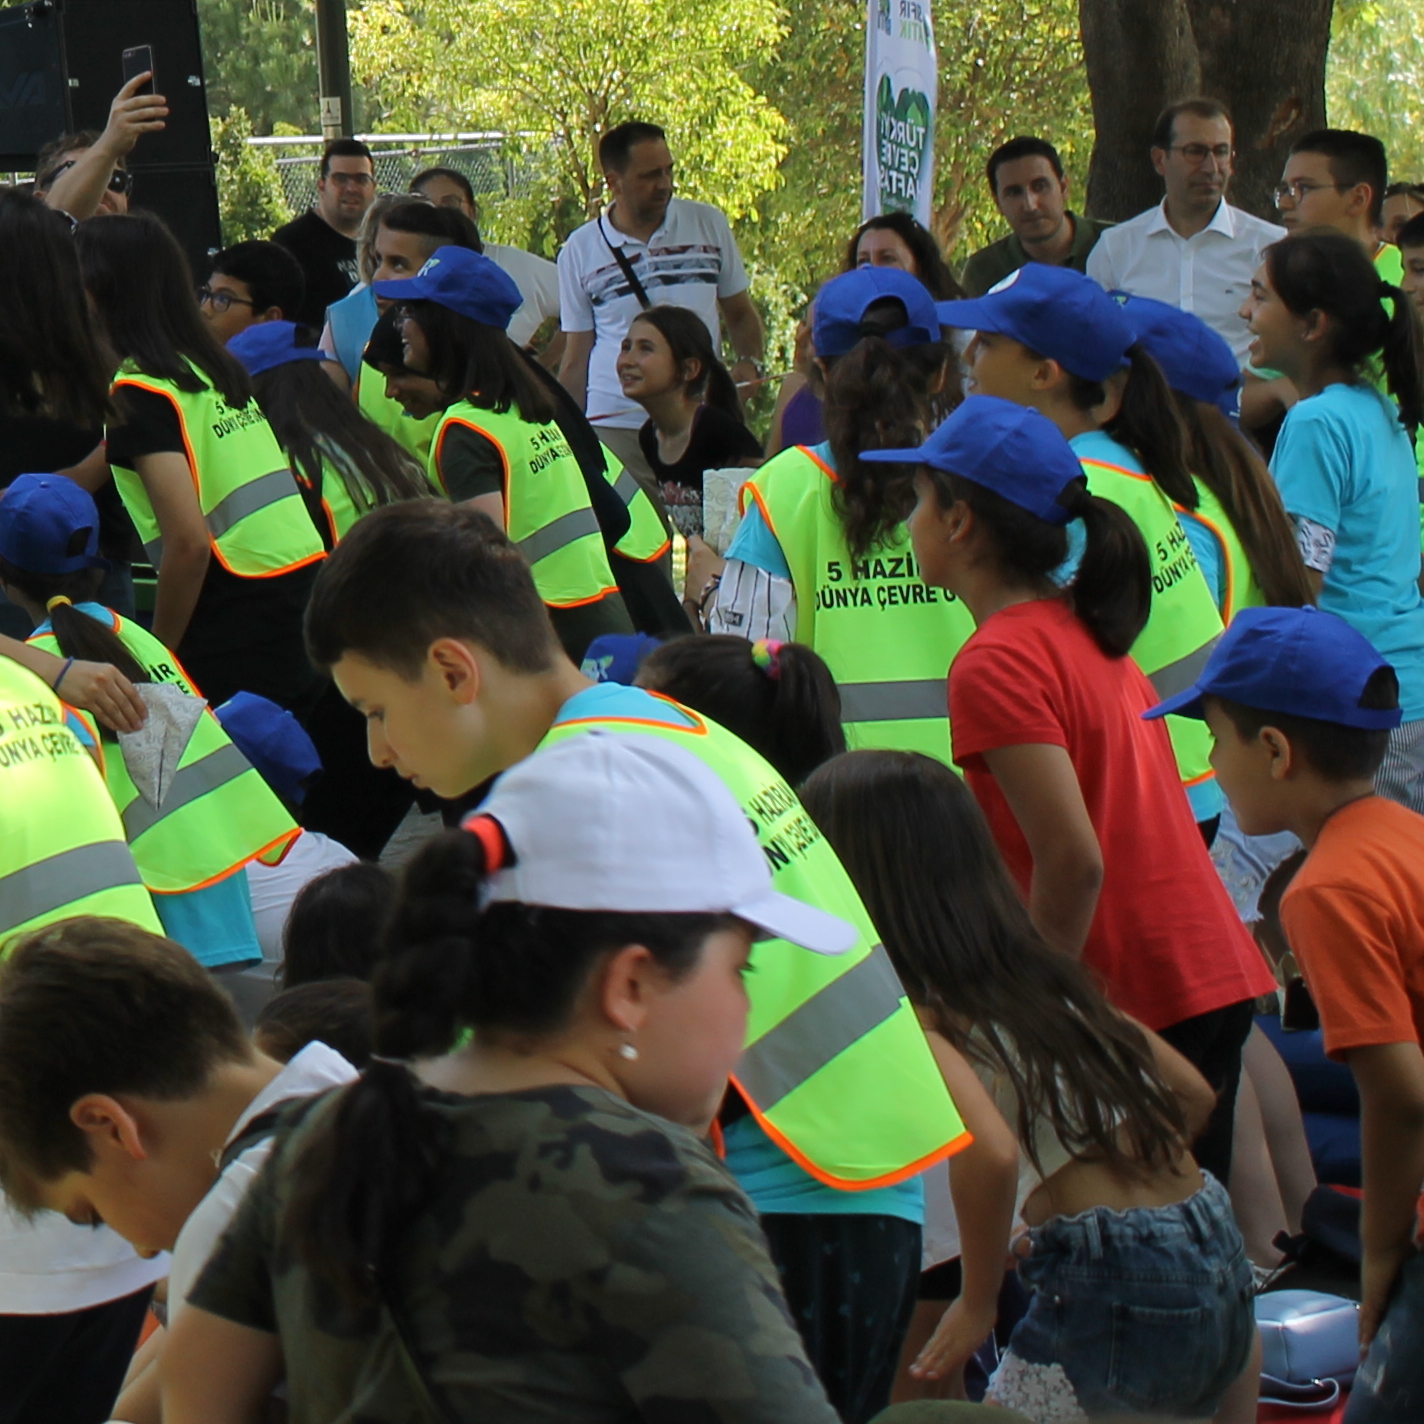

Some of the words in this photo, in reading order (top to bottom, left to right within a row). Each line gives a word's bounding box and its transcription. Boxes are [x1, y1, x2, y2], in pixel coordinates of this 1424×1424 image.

[1156, 540, 1168, 561] 5
[827, 561, 842, 582] 5
[853, 552, 920, 581] HAZİ
[876, 584, 938, 612] ÇEVRE
